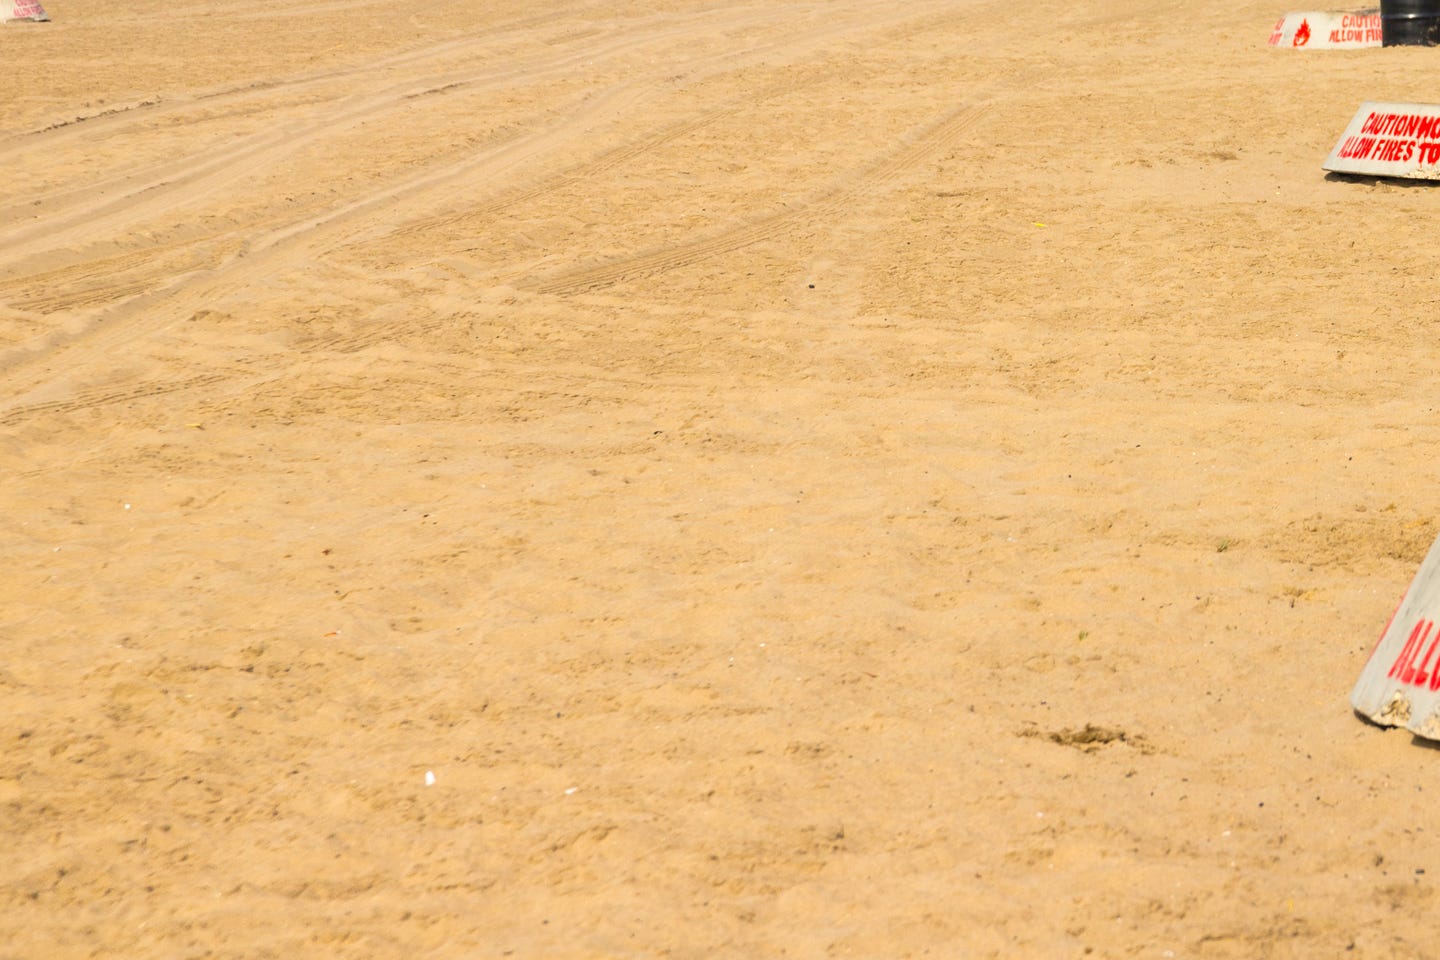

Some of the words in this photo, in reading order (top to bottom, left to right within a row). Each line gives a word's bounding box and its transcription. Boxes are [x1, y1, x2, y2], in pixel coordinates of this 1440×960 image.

[1328, 29, 1363, 42] ALLOW
[1361, 111, 1418, 138] CAUTION
[1337, 135, 1378, 159] ALLOW
[1374, 139, 1416, 162] FIRES
[1416, 143, 1440, 165] TO
